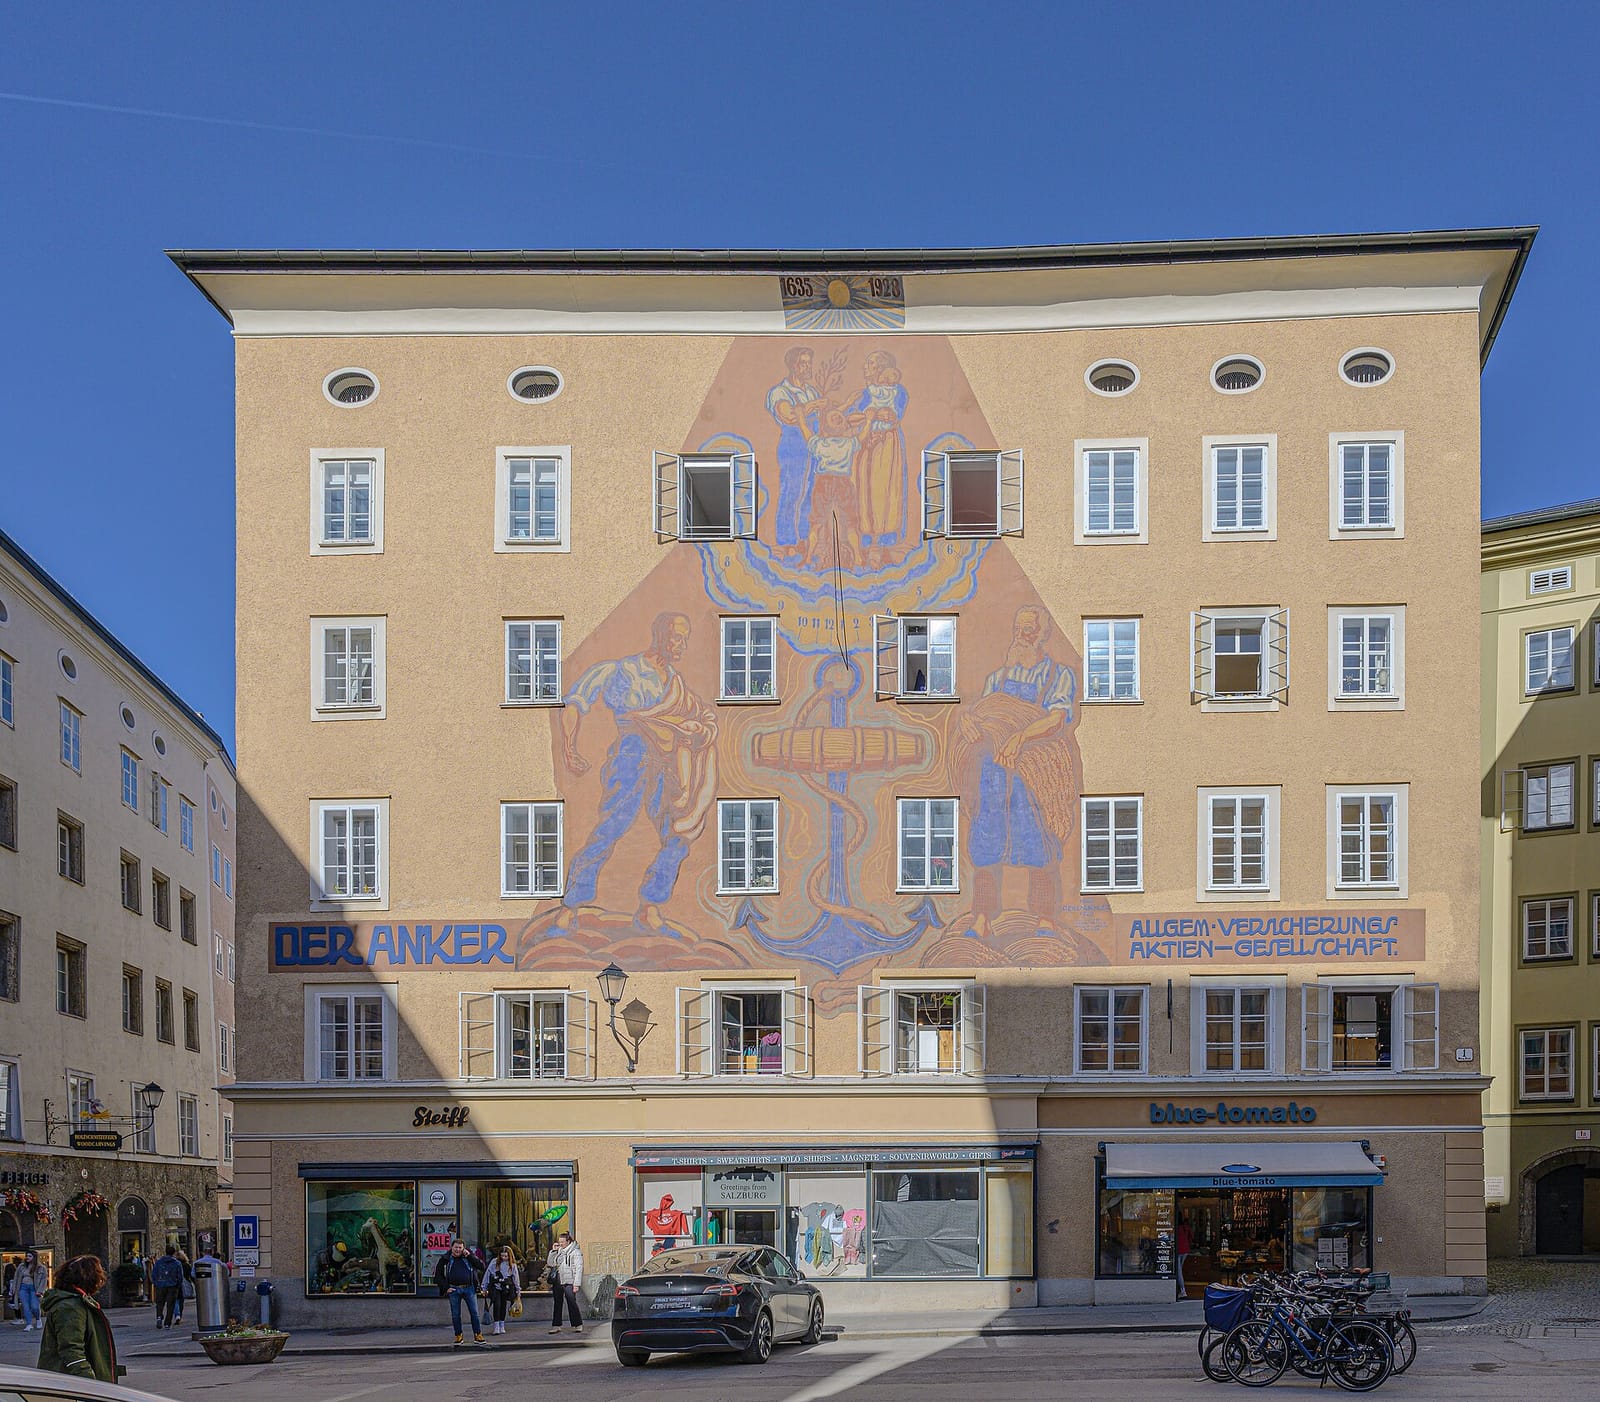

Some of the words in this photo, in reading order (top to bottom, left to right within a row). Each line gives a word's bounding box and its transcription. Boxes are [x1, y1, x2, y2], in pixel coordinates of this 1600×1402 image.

[780, 276, 814, 297] 1635
[868, 277, 901, 297] 1928
[798, 616, 808, 627] 10
[812, 618, 820, 628] 11
[825, 618, 834, 629] 12
[852, 618, 859, 628] 2
[275, 925, 363, 966] DER
[367, 923, 515, 965] ANKER
[412, 1106, 471, 1127] Steiff
[1150, 1101, 1317, 1123] blue-tomato
[716, 1156, 771, 1164] SWEATSHIRTS
[780, 1155, 800, 1163] POLO
[803, 1155, 832, 1163] SHIRTS
[841, 1153, 880, 1161] MAGNETE
[888, 1151, 959, 1160] SOUVENIRWORLD
[7, 1171, 50, 1184] BERGER
[1212, 1177, 1276, 1186] blue-tomato
[720, 1183, 751, 1192] Greetings
[720, 1191, 767, 1200] SALZBURG
[428, 1235, 450, 1248] SALE
